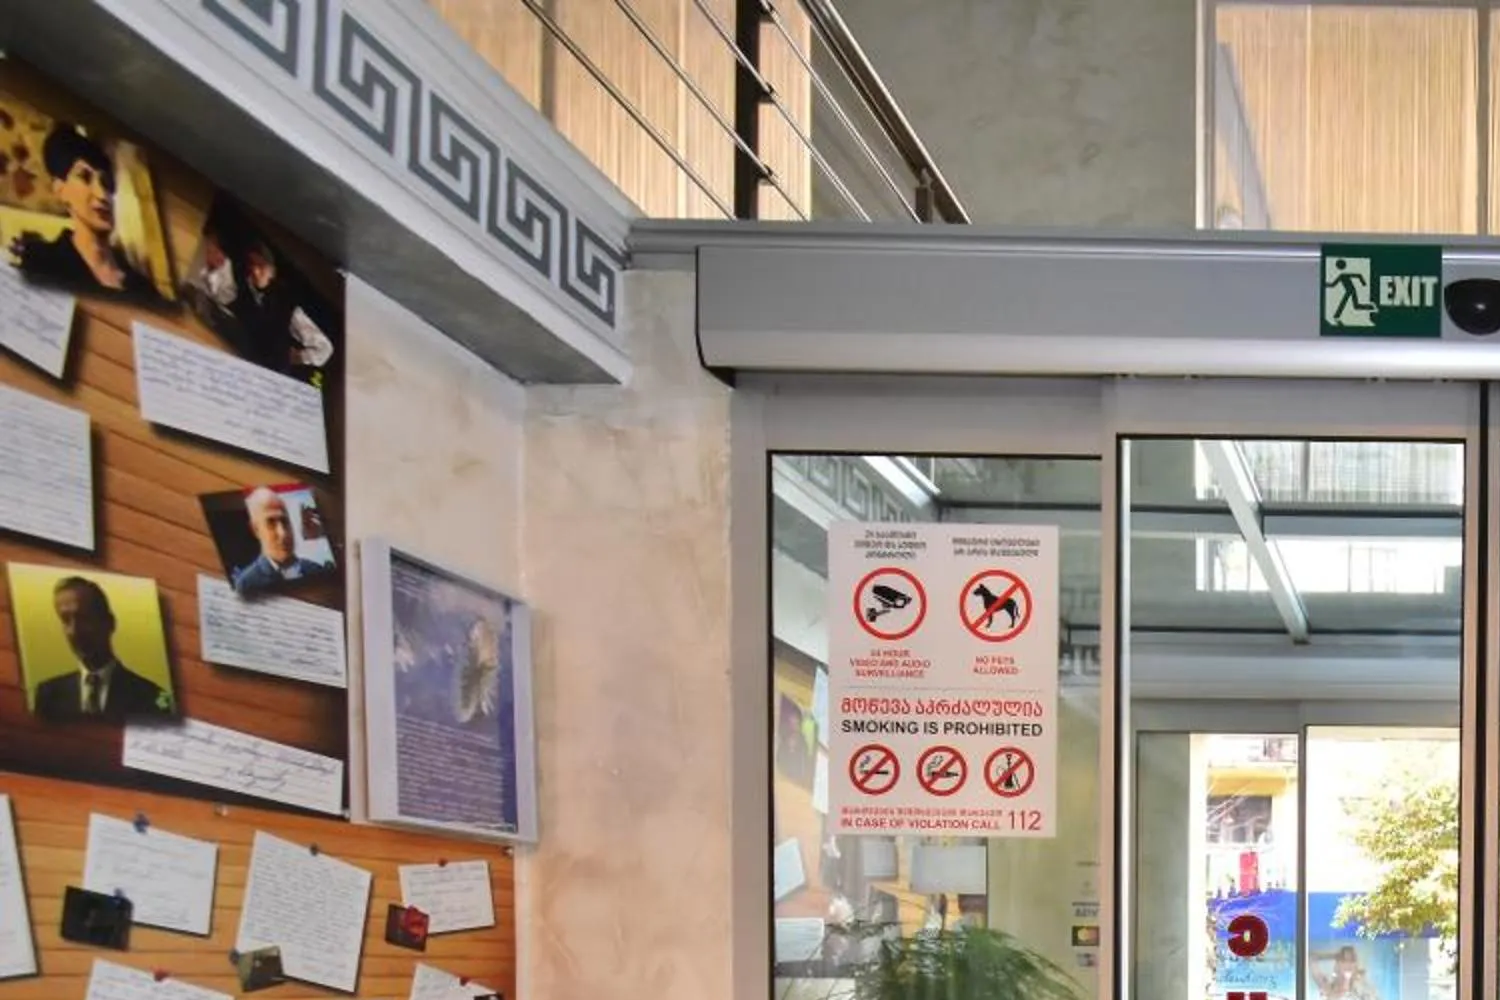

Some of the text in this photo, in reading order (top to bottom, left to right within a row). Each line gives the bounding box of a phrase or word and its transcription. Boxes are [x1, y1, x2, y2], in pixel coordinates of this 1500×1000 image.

[1379, 275, 1438, 307] EXIT
[973, 667, 1018, 675] ALLOWED
[841, 719, 1043, 737] SMOKING IS PROHIBITED
[856, 818, 887, 828] CASE
[908, 819, 969, 829] VIOLATION
[972, 820, 1000, 830] CALL
[1008, 810, 1041, 830] 112
